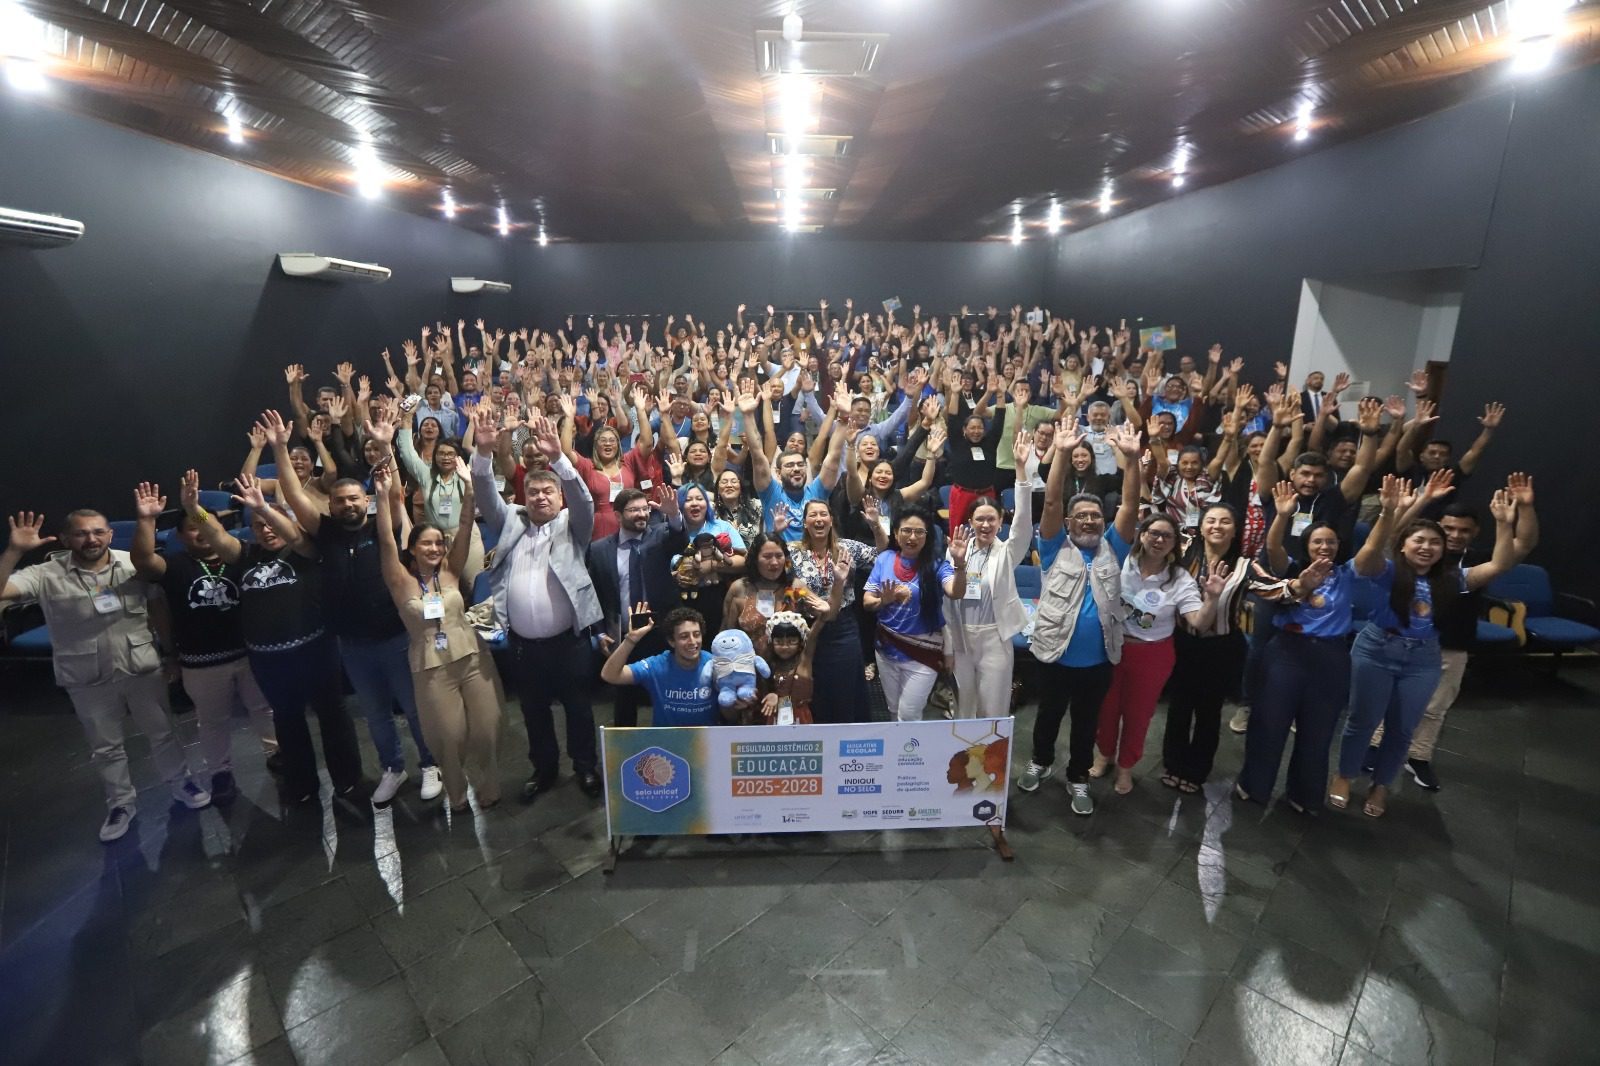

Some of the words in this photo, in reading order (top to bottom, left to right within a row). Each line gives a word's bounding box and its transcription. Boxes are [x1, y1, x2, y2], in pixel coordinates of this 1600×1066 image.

[665, 687, 698, 700] unicef
[736, 744, 776, 753] RESULTADO
[777, 743, 814, 752] SISTÊMICO
[815, 743, 820, 752] 2
[737, 756, 818, 775] EDUCAÇÃO
[635, 788, 652, 796] selo
[653, 787, 679, 796] unicef
[736, 779, 818, 795] 2025-2028
[858, 785, 876, 793] SELO
